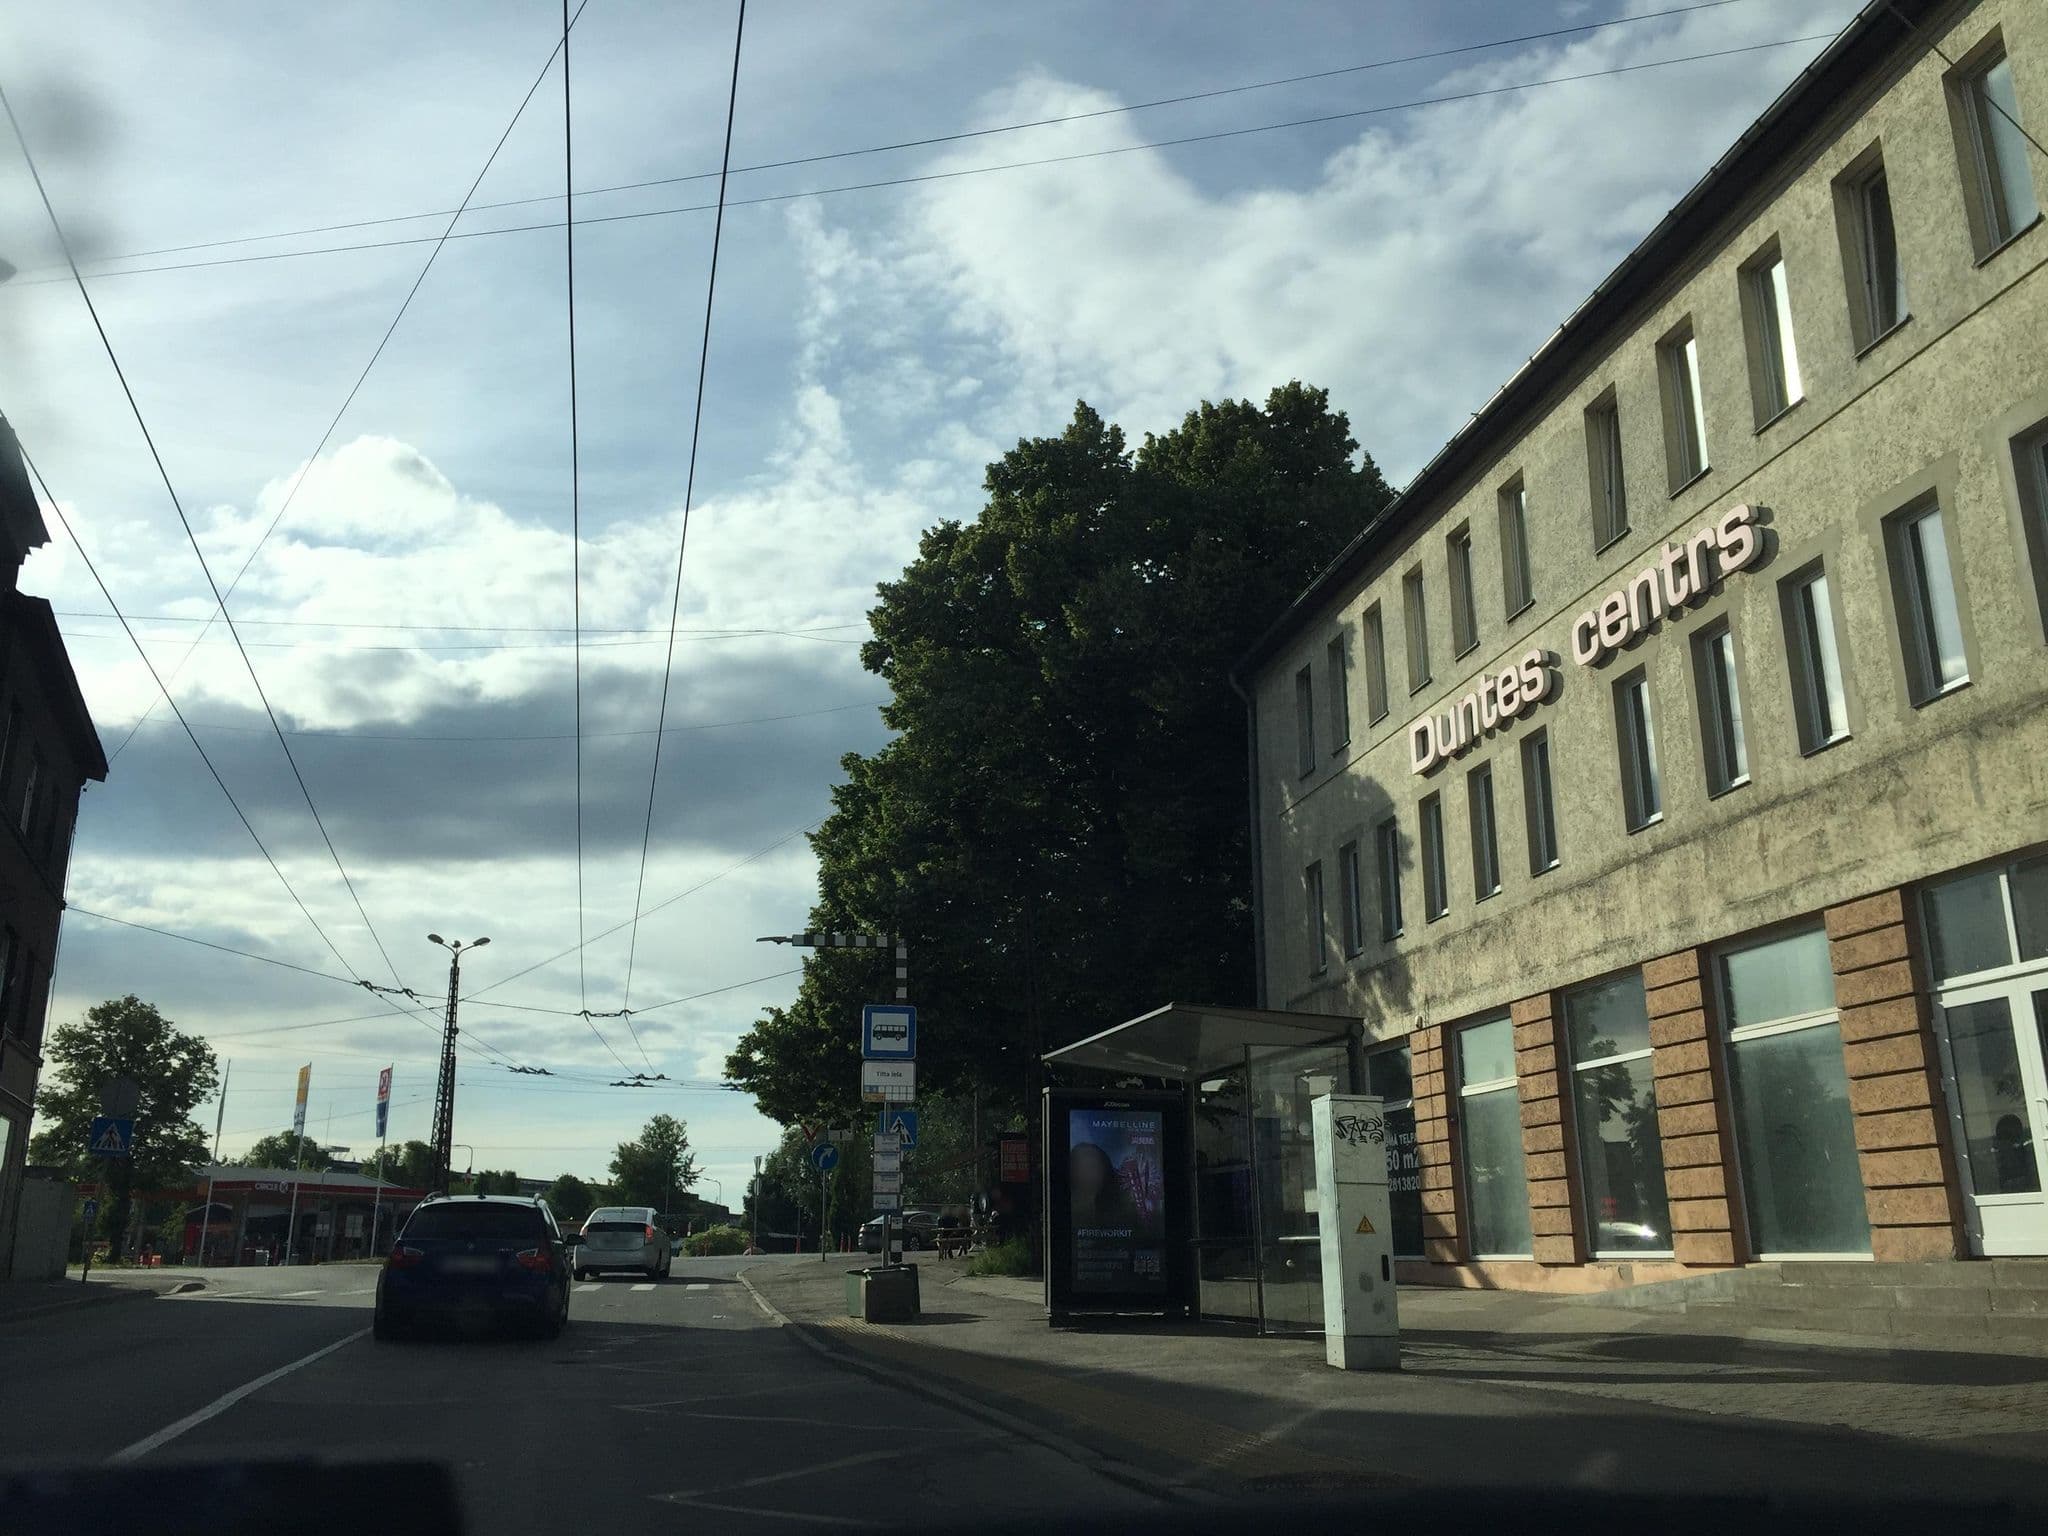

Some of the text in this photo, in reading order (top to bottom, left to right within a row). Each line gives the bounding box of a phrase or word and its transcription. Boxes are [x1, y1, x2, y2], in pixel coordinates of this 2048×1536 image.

[1409, 504, 1761, 775] Duntes centrs
[1092, 1120, 1155, 1129] MAYBELLINE
